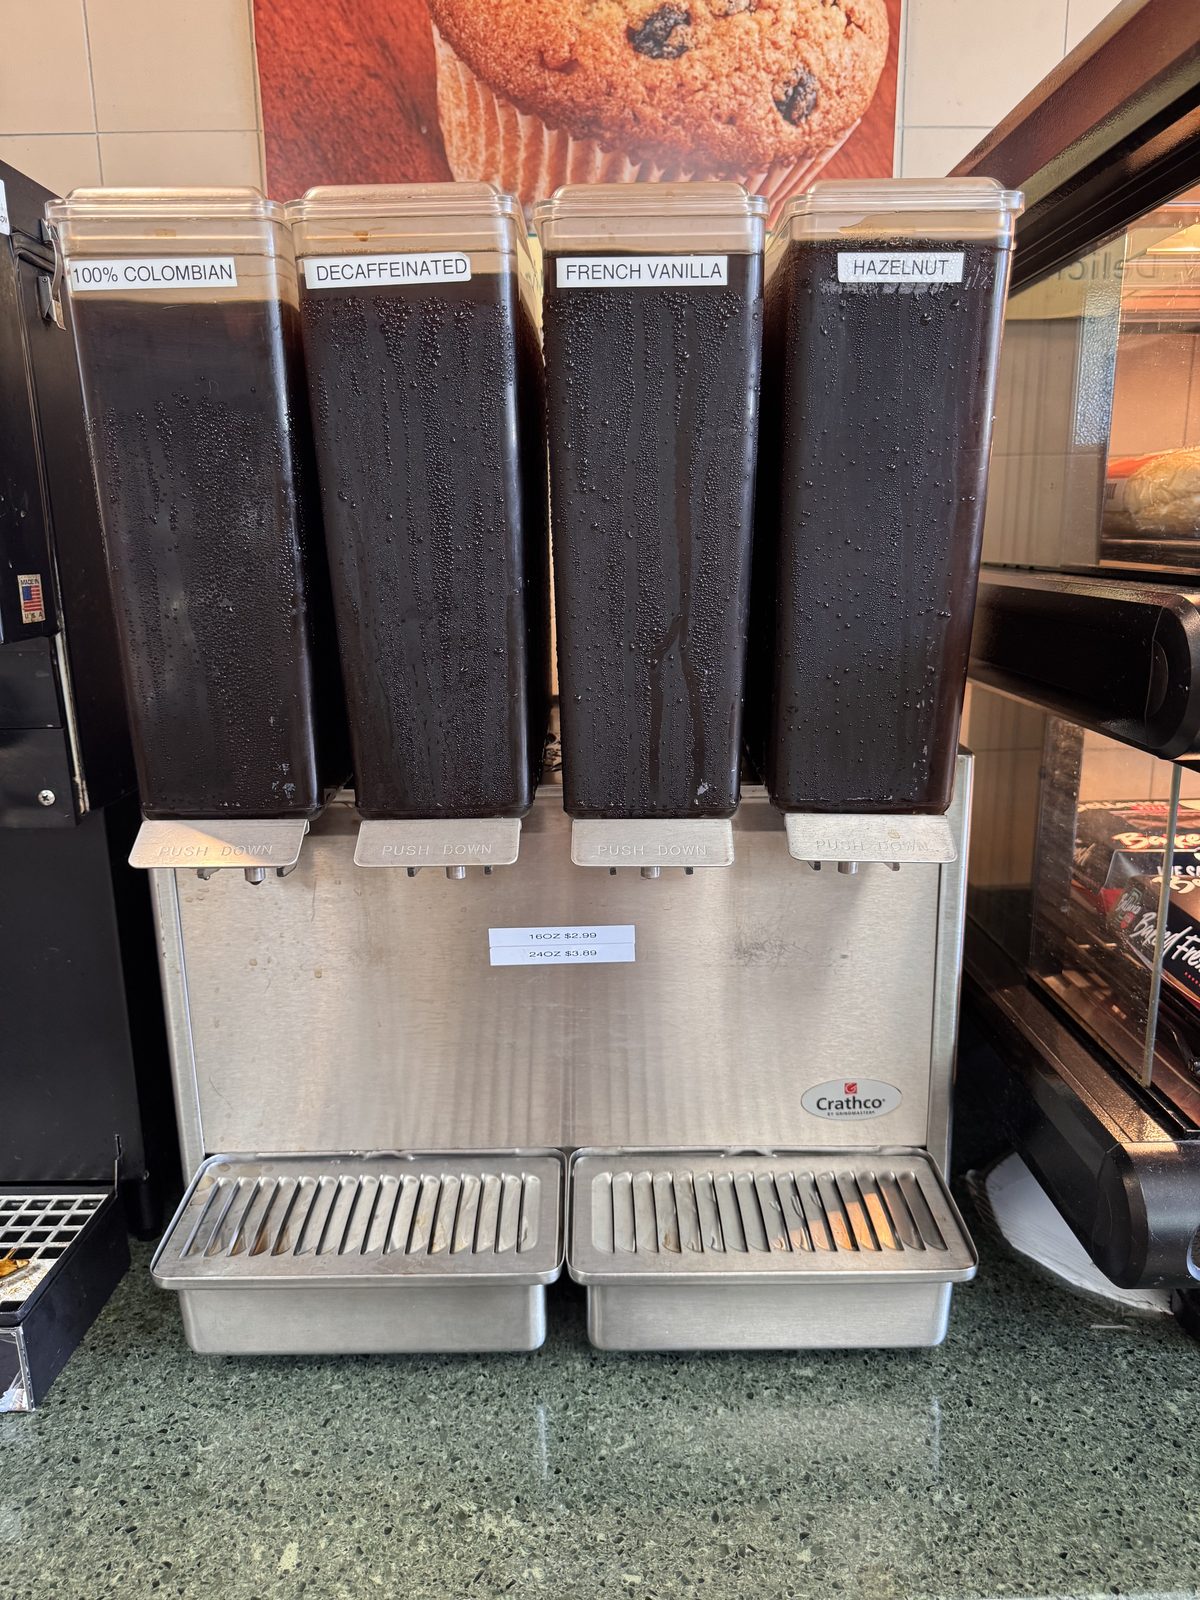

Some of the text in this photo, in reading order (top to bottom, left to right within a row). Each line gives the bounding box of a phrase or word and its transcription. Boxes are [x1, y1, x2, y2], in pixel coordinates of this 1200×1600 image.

[73, 264, 233, 283] 100% COLOMBIAN
[316, 258, 467, 281] DECAFFEINATED
[566, 262, 722, 280] FRENCH VANILLA
[853, 259, 949, 276] HAZELNUT
[157, 844, 273, 857] PUSH DOWN
[382, 843, 492, 856] PUSH DOWN
[597, 844, 707, 856] PUSH DOWN
[815, 839, 930, 851] PUSH DOWN
[529, 949, 597, 958] 24OZ $3.89
[816, 1095, 883, 1111] Crathco
